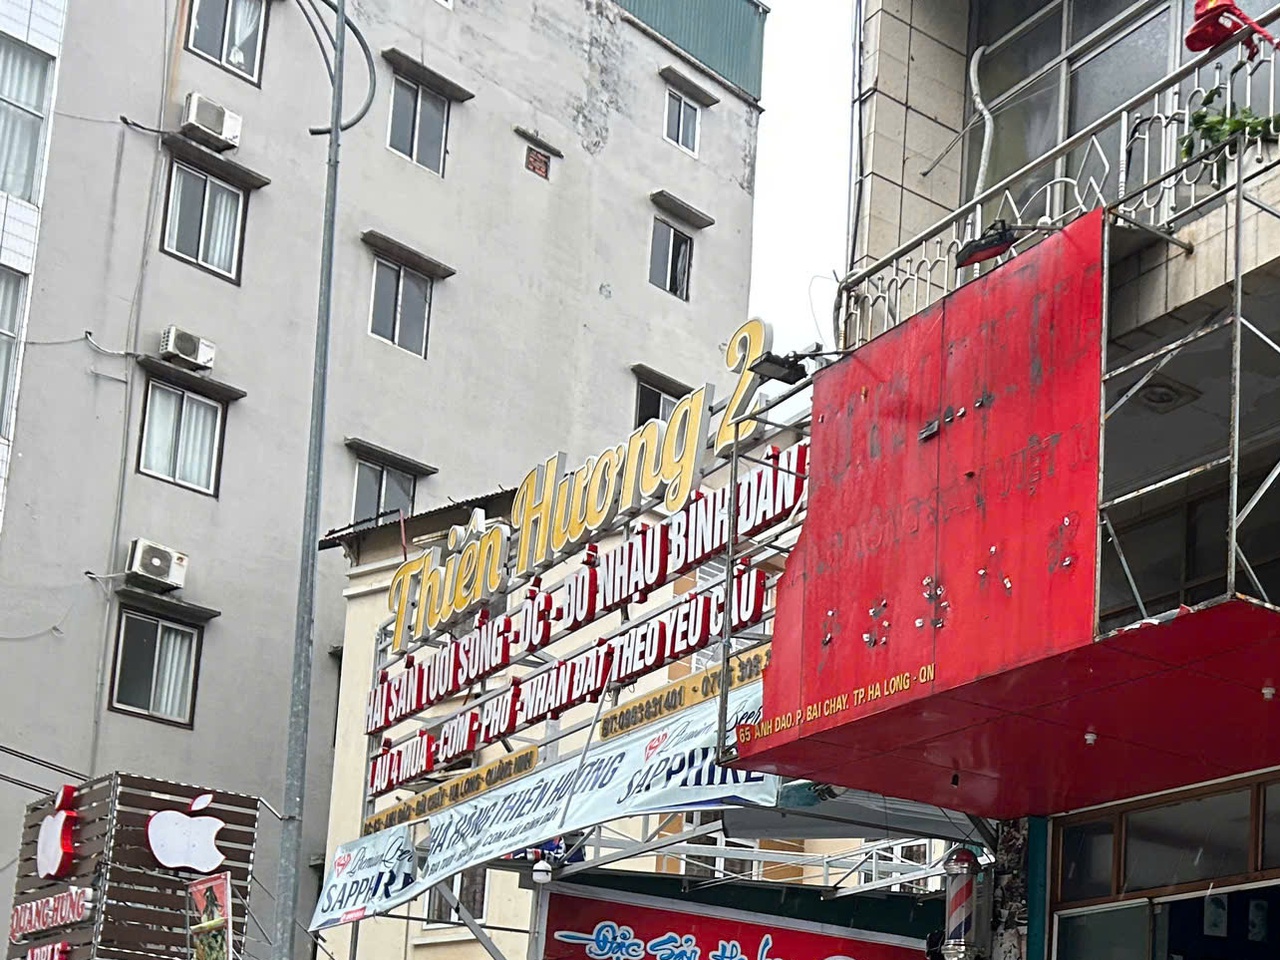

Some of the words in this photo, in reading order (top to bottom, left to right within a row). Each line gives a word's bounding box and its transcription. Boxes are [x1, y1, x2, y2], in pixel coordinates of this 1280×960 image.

[389, 508, 510, 654] Thiên
[512, 382, 711, 577] Hương
[714, 316, 772, 457] 2
[366, 670, 389, 733] HẢI
[388, 654, 419, 722] SẢN
[421, 638, 459, 705] TƯƠI
[457, 609, 511, 686] SỐNG
[520, 576, 553, 651] ỐC
[562, 543, 597, 629] ĐỒ
[597, 521, 668, 606] NHẬU
[670, 489, 734, 573] BÌNH
[736, 445, 804, 532] DÂN
[438, 713, 473, 762] CƠM
[480, 677, 518, 743] PHỞ
[573, 637, 607, 702] ĐẶT
[606, 620, 662, 682] THEO
[663, 592, 707, 658] YÊU
[709, 556, 763, 636] CẦU
[739, 725, 751, 744] 65
[754, 719, 773, 740] ANH
[806, 702, 822, 722] BAI
[823, 693, 849, 717] CHAY.
[853, 688, 867, 707] TP.
[867, 684, 882, 703] HA
[883, 671, 911, 696] LONG
[919, 663, 935, 685] QN
[429, 815, 453, 855] HÀ
[494, 777, 552, 827] THIÊN
